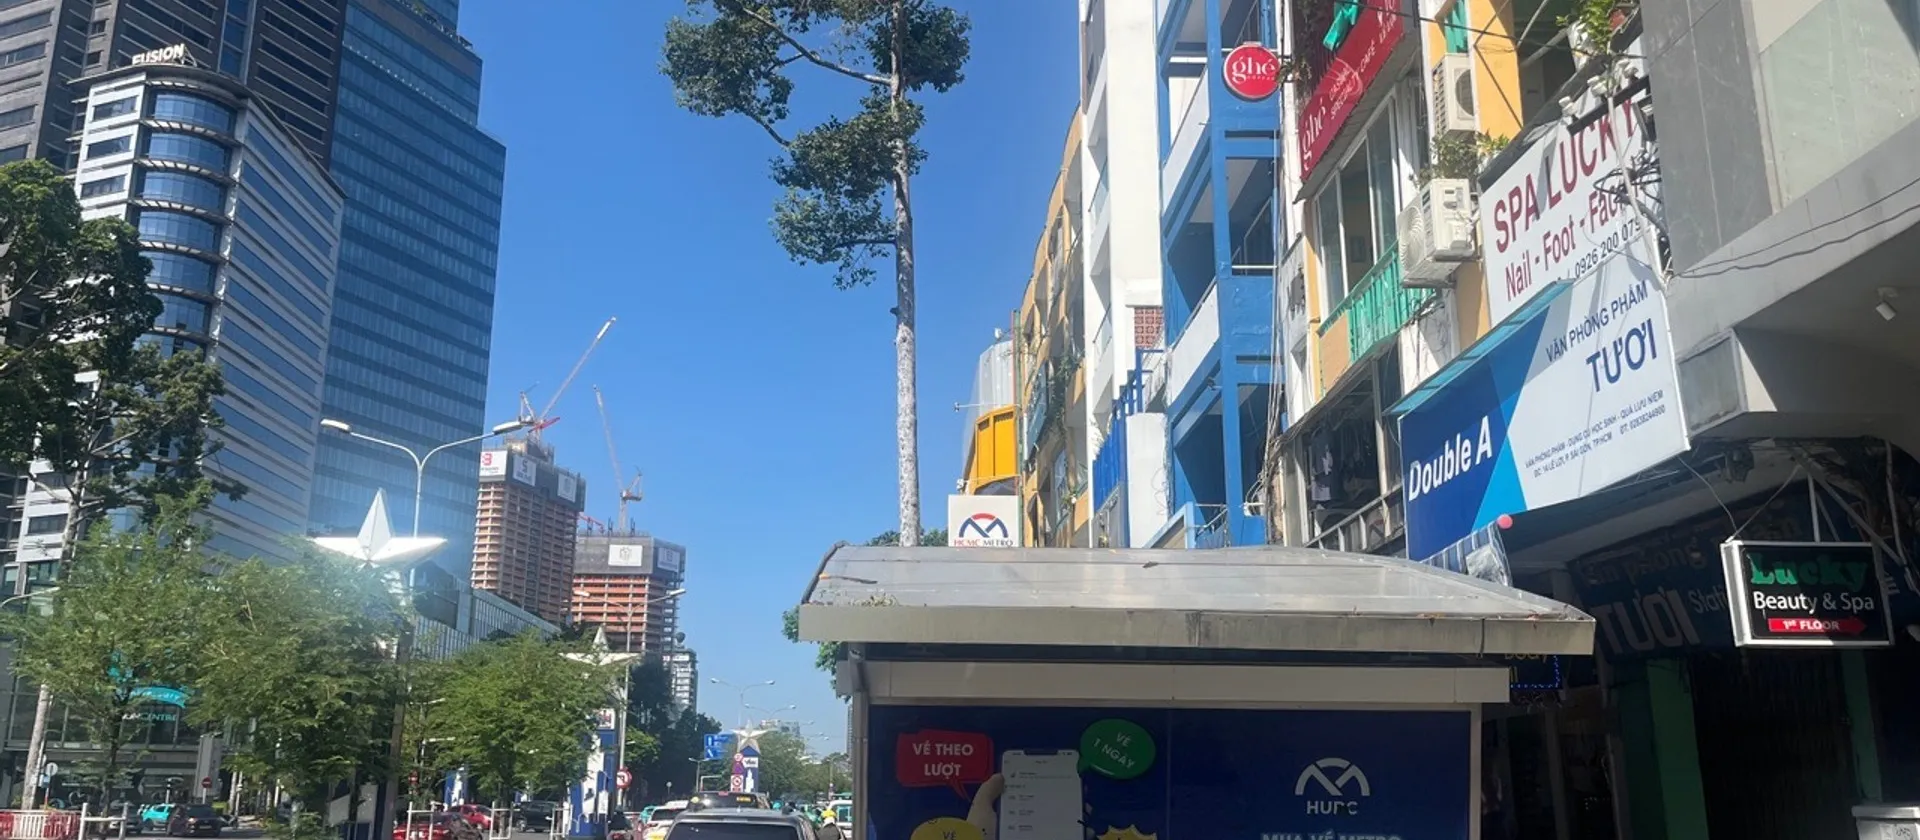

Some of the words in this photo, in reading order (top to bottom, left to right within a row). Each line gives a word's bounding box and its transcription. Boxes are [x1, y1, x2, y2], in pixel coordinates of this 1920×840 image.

[1494, 174, 1540, 254] SPA
[1505, 250, 1533, 301] Nail
[1543, 214, 1576, 271] Foot
[1574, 250, 1599, 279] 0926
[1601, 230, 1620, 260] 200
[1545, 334, 1568, 362] VĂN
[1568, 306, 1609, 348] PHÒNG
[1610, 279, 1648, 320] PHẨM
[1585, 317, 1657, 392] TƯƠI
[1408, 432, 1472, 502] Double
[1475, 414, 1493, 466] A
[983, 539, 1014, 547] METRO
[1747, 552, 1867, 592] Lucky
[1753, 591, 1818, 614] Beauty
[1822, 592, 1837, 609] &
[1840, 592, 1875, 614] Spa
[1800, 619, 1840, 630] FLOOR
[911, 740, 931, 756] VÉ
[935, 743, 974, 756] THEO
[1116, 731, 1132, 747] VÉ
[923, 762, 963, 780] LƯỢT
[1101, 743, 1136, 769] NGÀY
